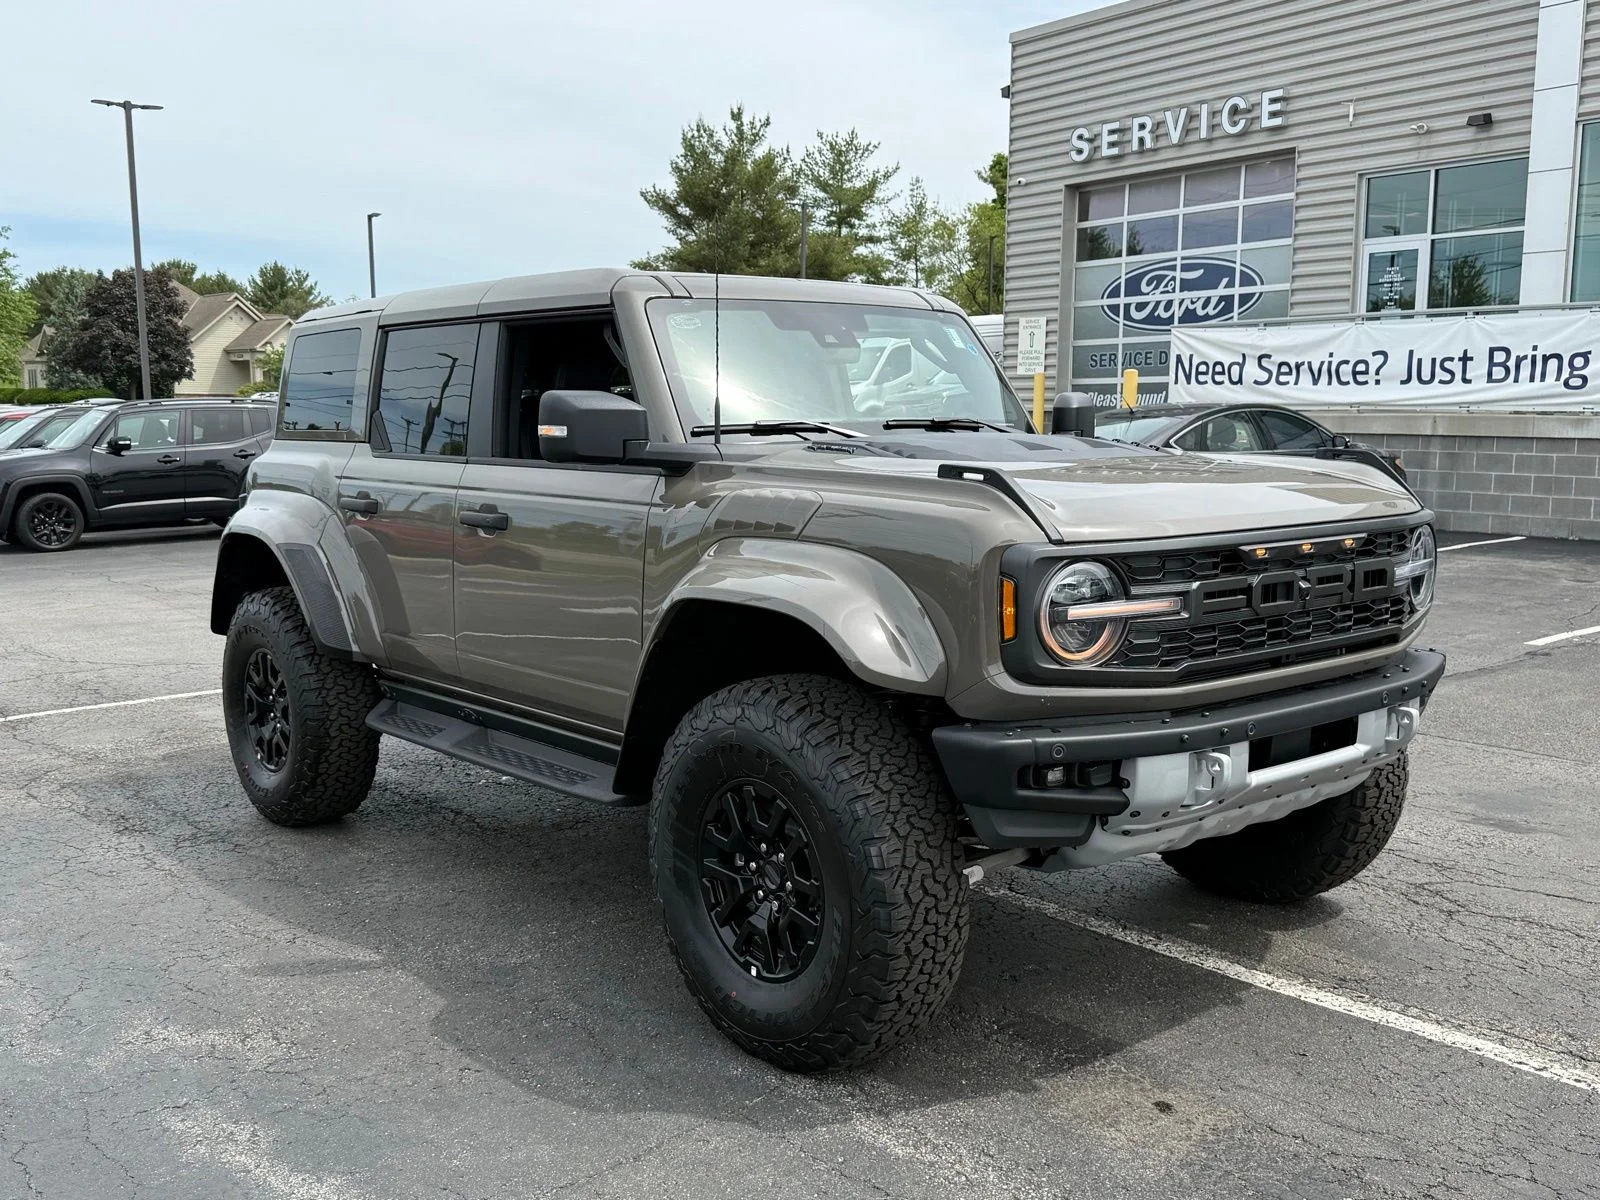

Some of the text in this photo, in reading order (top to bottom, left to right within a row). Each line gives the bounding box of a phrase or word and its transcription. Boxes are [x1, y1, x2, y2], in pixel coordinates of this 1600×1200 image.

[1070, 88, 1287, 162] SERVICE
[1129, 268, 1230, 320] Ford
[1174, 344, 1592, 390] Need Service? Just Bring
[1192, 557, 1394, 627] FORD
